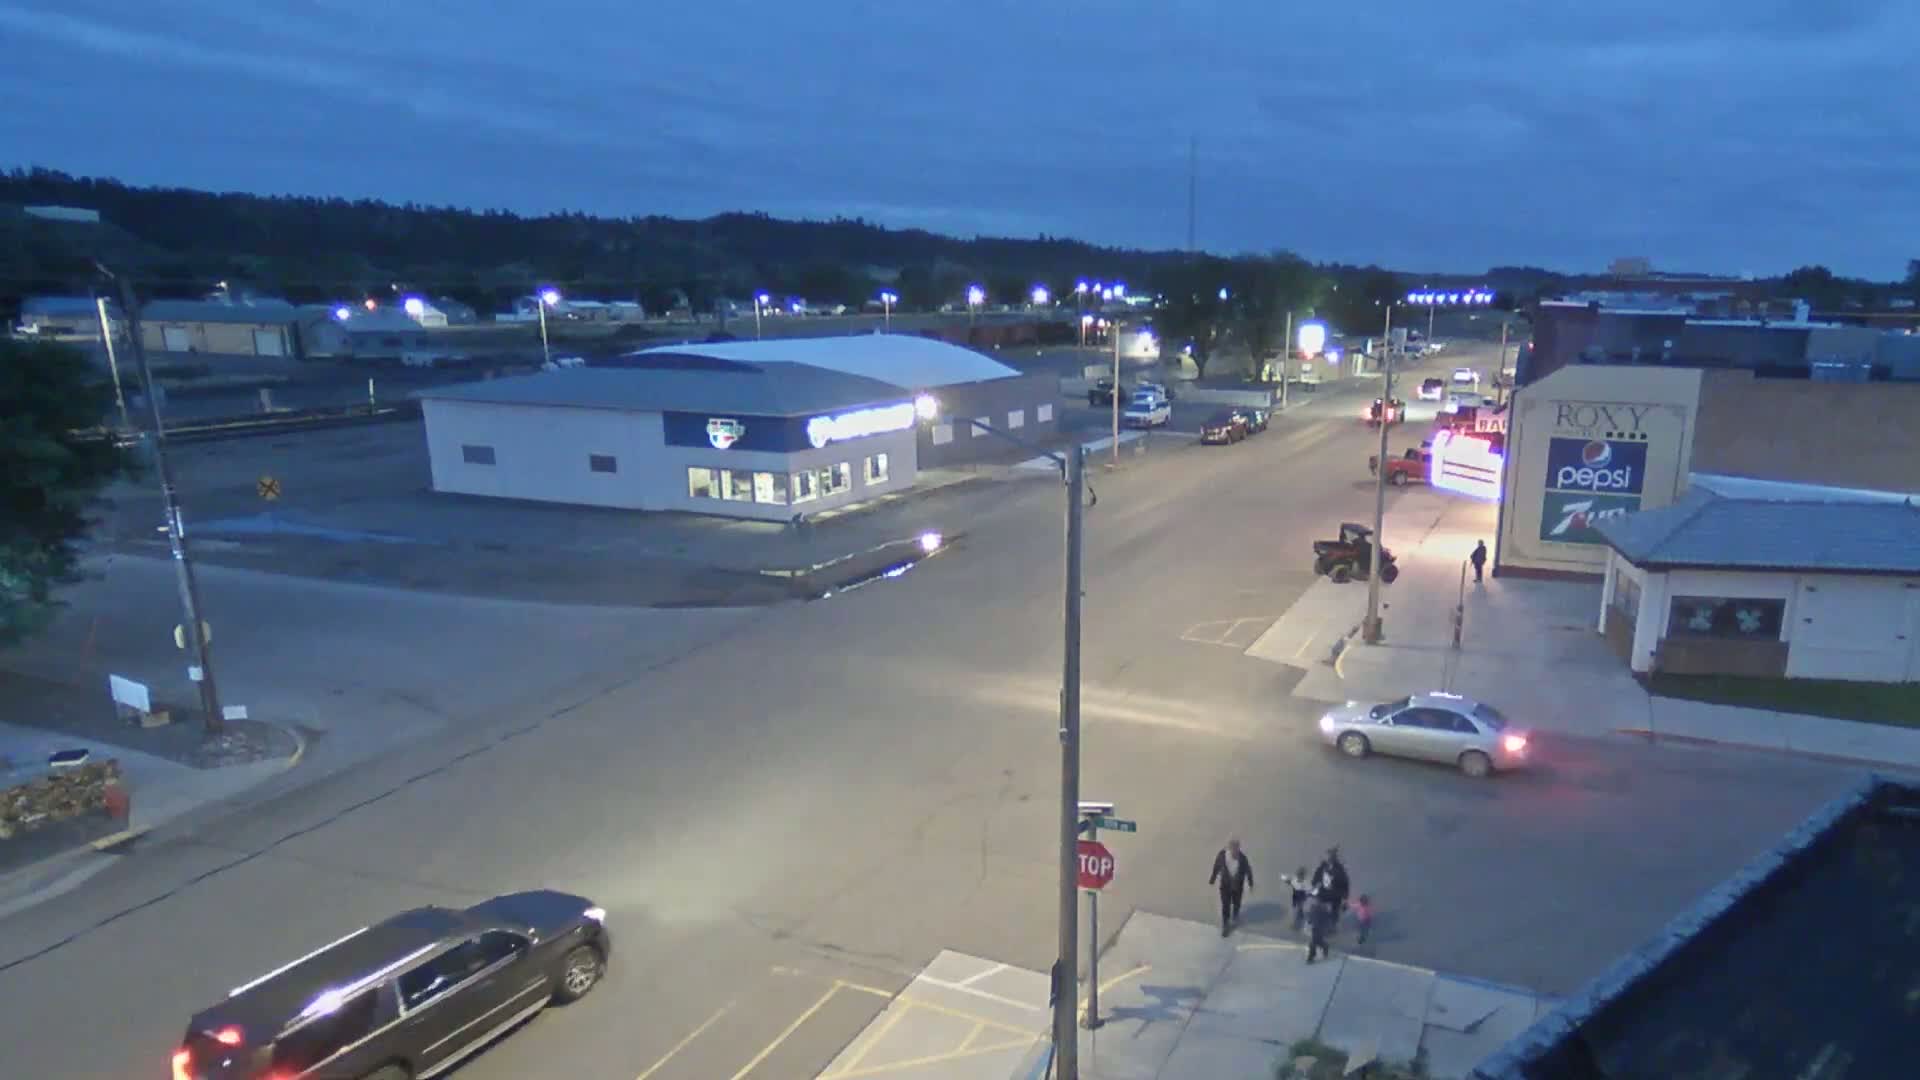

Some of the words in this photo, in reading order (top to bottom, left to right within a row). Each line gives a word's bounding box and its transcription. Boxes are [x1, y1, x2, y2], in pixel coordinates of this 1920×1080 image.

[1480, 419, 1506, 431] BA
[1555, 404, 1648, 430] ROXY
[1557, 464, 1632, 491] pepsi
[1079, 855, 1112, 877] TOP
